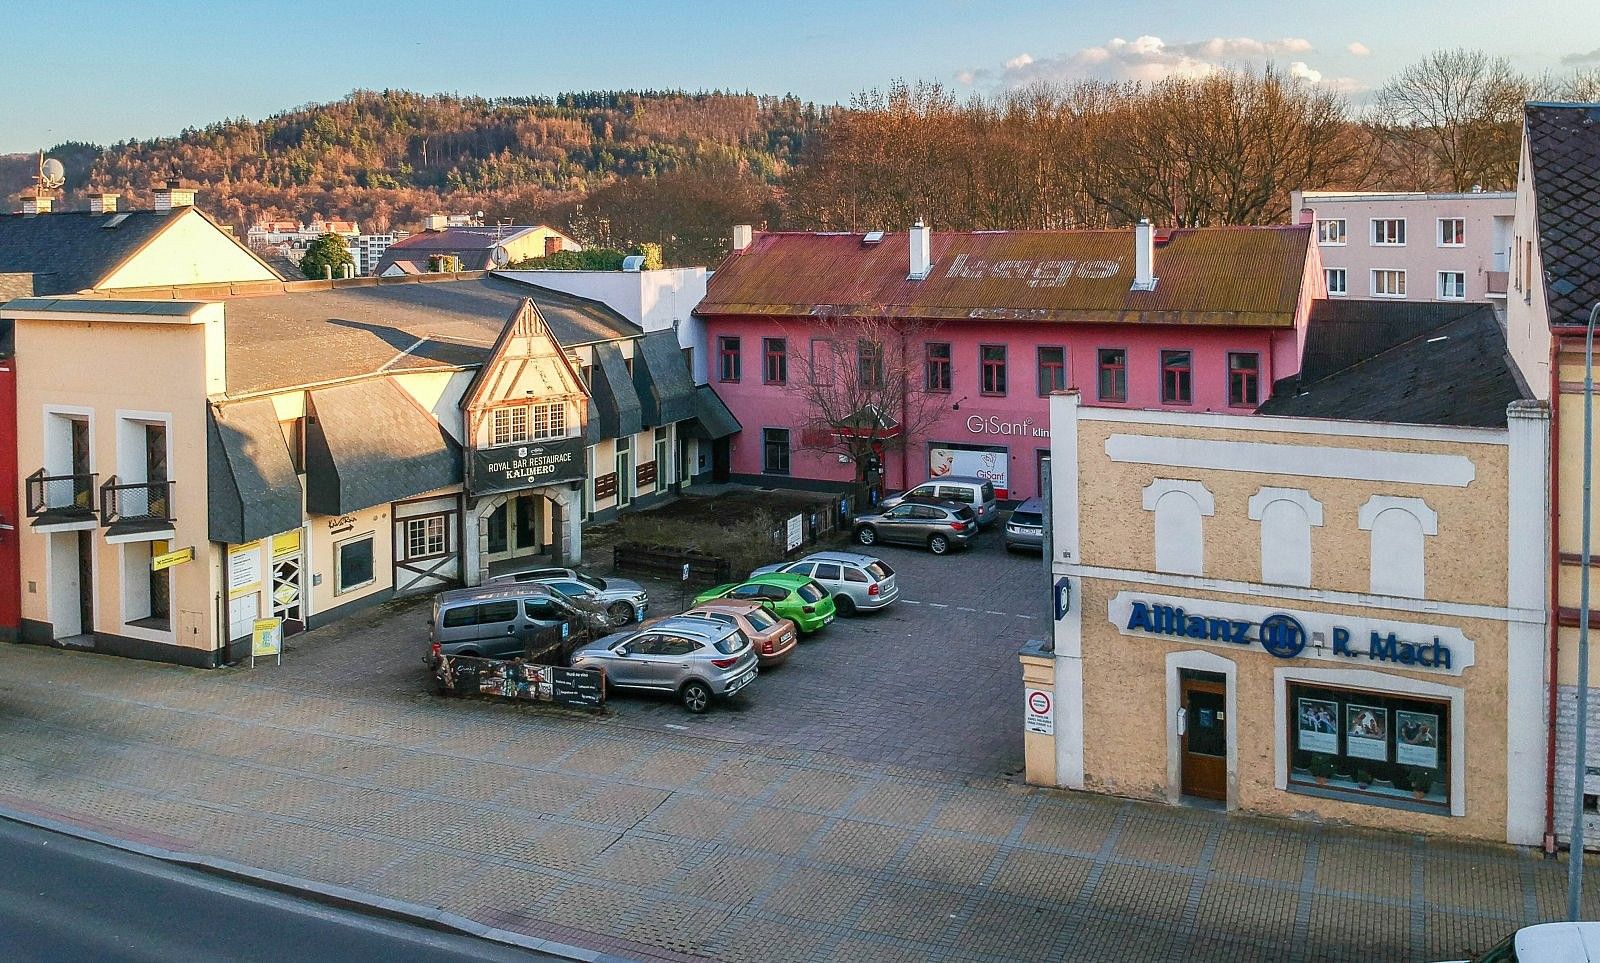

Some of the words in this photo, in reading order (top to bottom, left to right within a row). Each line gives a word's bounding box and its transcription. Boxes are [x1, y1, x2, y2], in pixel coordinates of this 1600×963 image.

[1032, 427, 1050, 438] klin
[488, 461, 511, 473] ROYAL
[513, 459, 527, 469] BAR
[529, 452, 572, 467] RESTAURACE
[506, 464, 555, 479] KALIMERO
[1127, 601, 1251, 645] Allianz
[1332, 627, 1358, 658] R.
[1369, 630, 1451, 669] Mach
